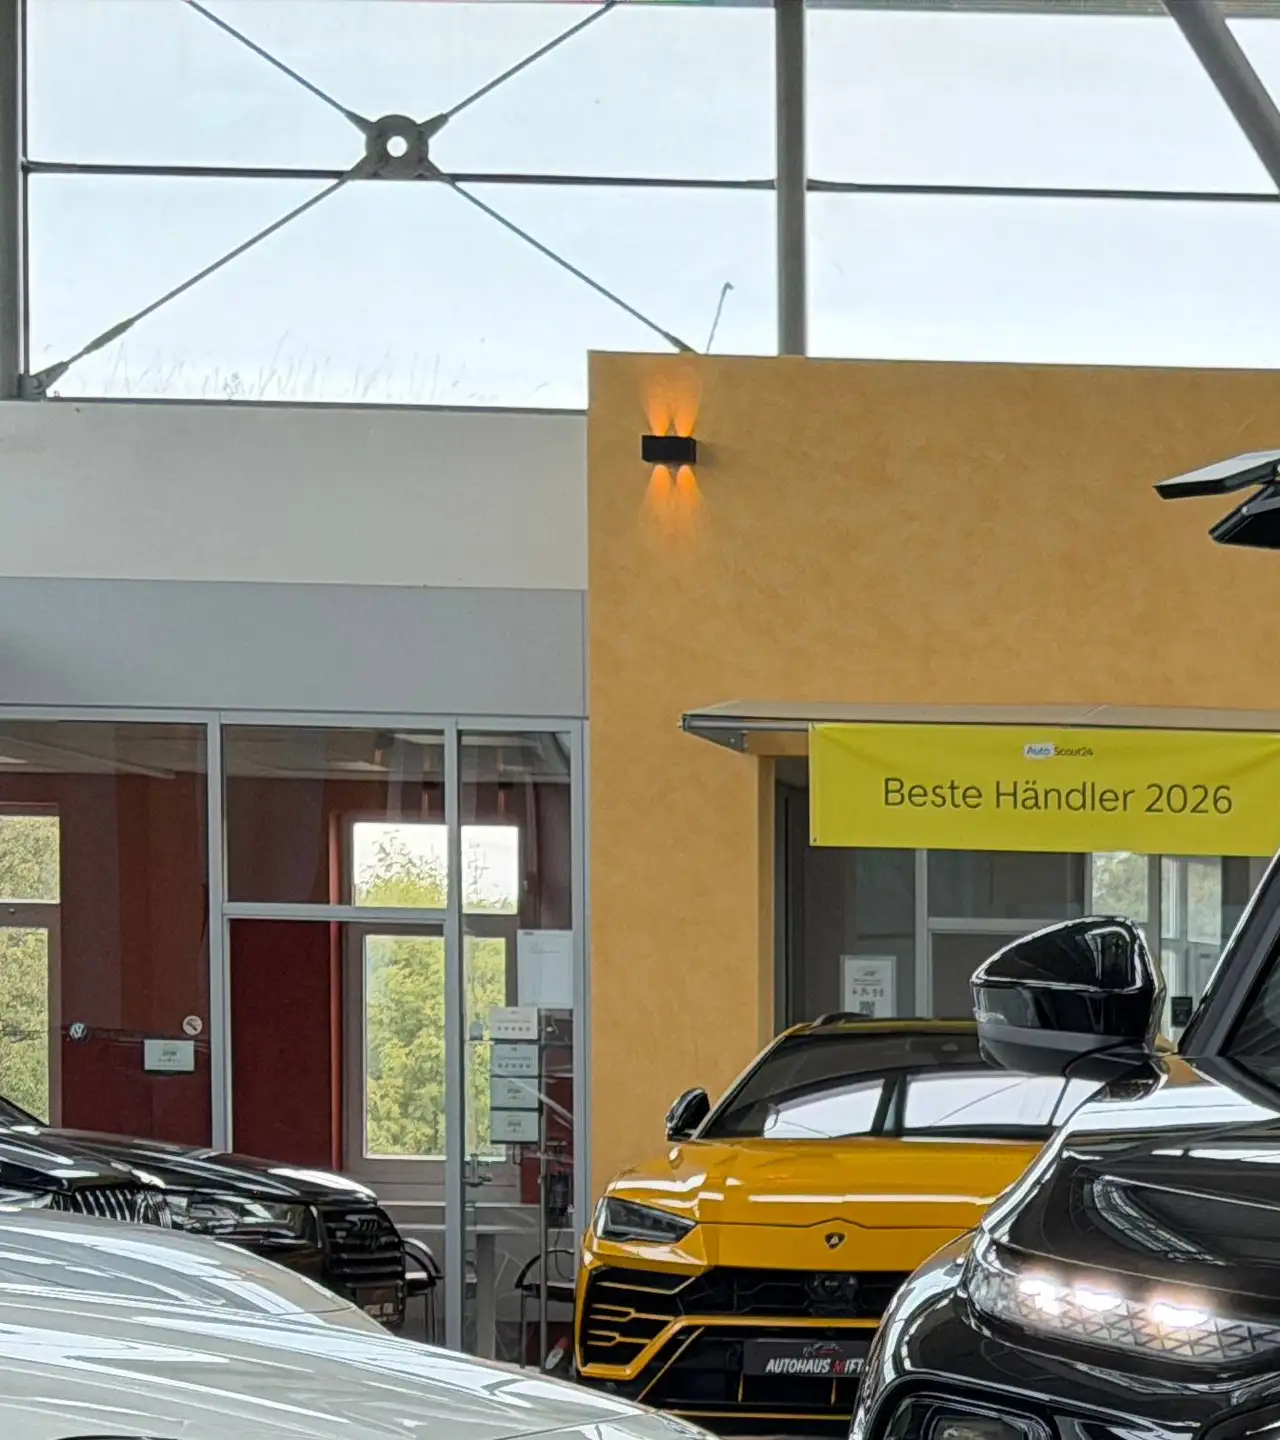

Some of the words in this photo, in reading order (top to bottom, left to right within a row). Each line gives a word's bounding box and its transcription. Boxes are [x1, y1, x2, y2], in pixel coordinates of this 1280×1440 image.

[884, 777, 983, 809] Beste
[995, 779, 1134, 812] Händler
[1144, 784, 1233, 815] 2026
[765, 1358, 832, 1374] AUTOHAUS
